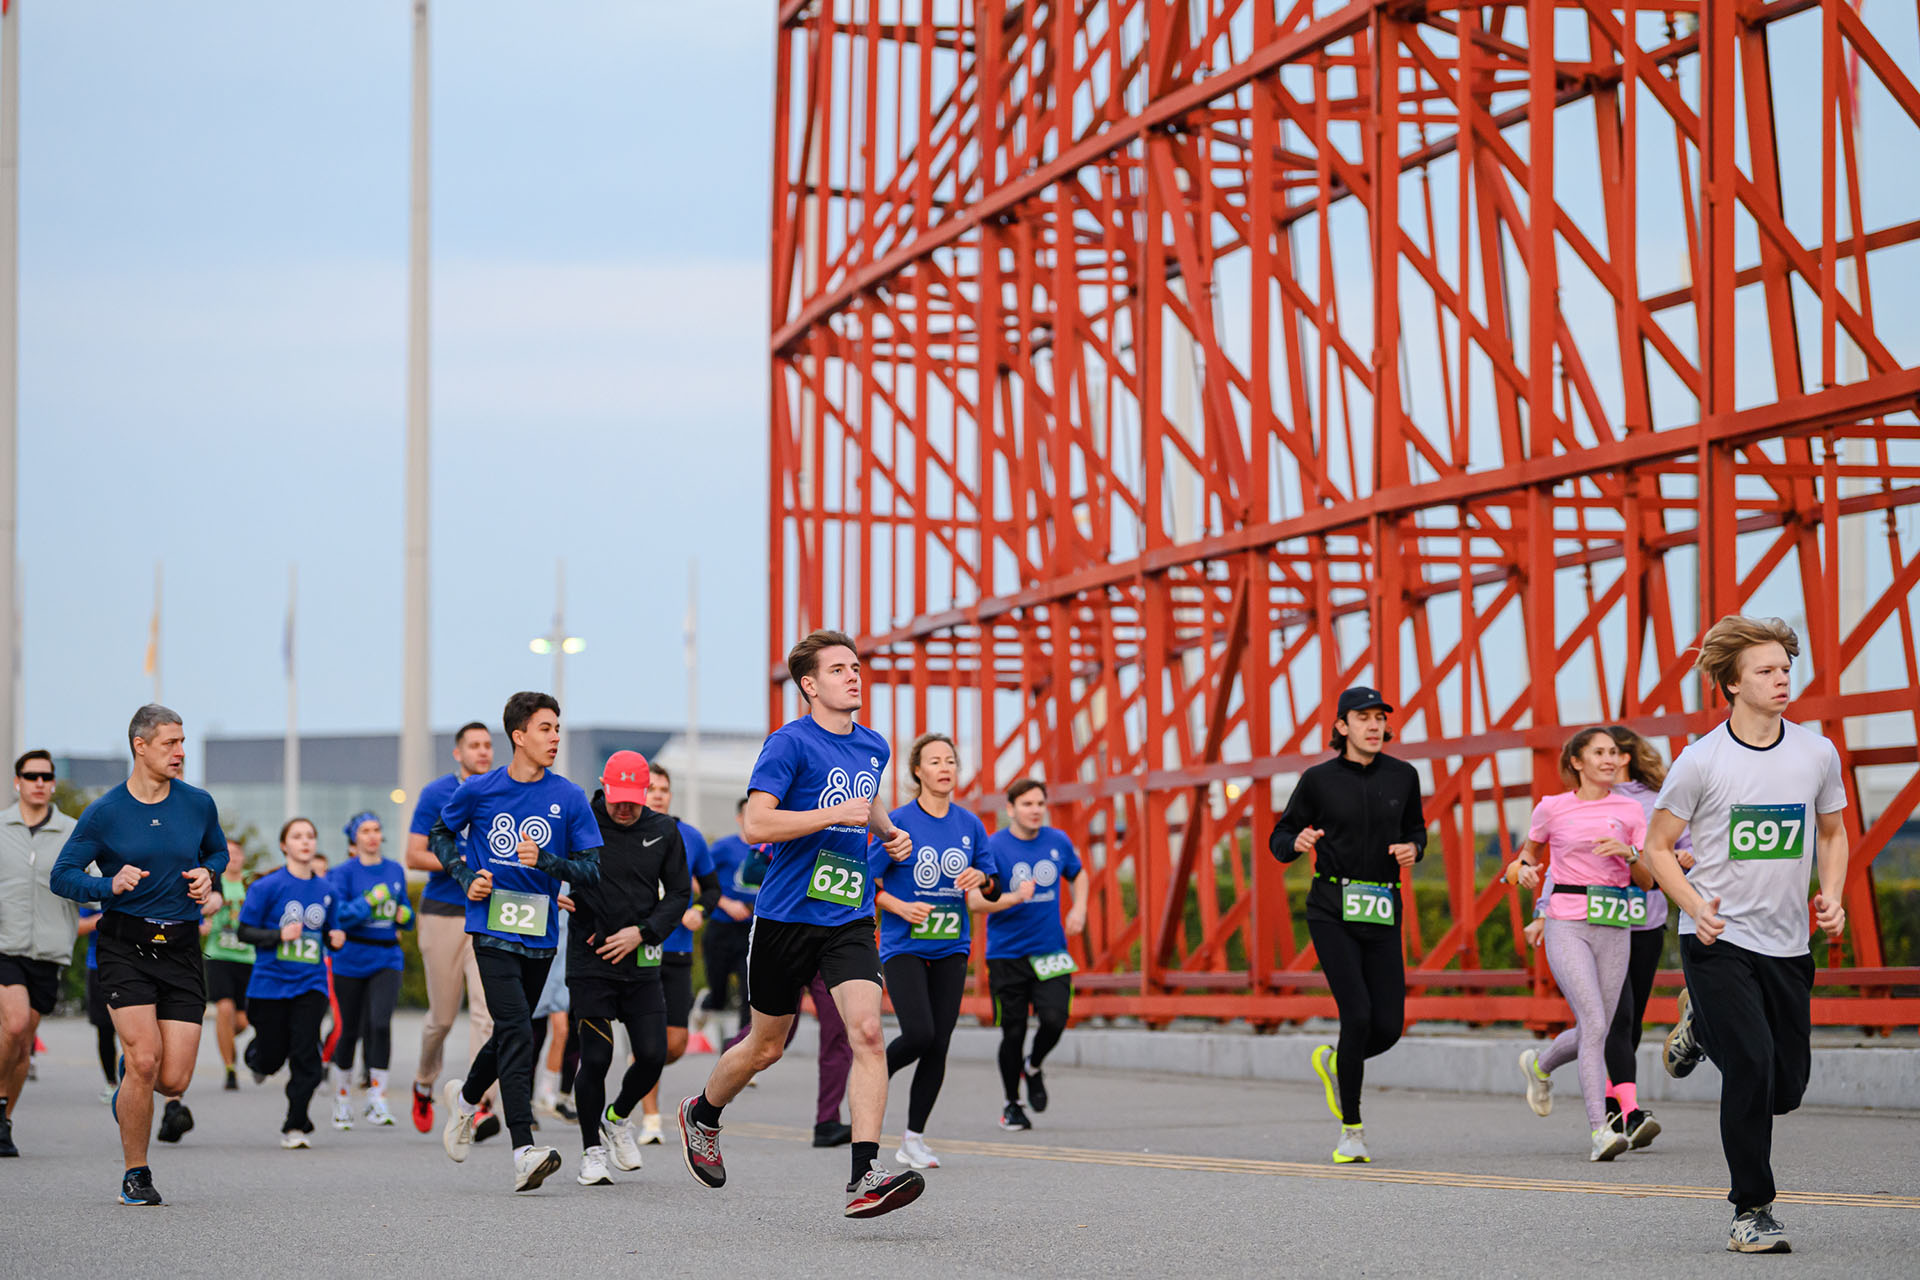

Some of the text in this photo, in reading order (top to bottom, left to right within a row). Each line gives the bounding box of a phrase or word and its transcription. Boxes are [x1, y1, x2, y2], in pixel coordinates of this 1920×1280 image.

[487, 812, 552, 858] 80
[1732, 820, 1801, 852] 697
[813, 865, 863, 899] 623
[913, 846, 968, 889] 80
[499, 902, 536, 928] 82
[1346, 894, 1392, 919] 570
[914, 912, 960, 934] 372
[1034, 953, 1074, 976] 660
